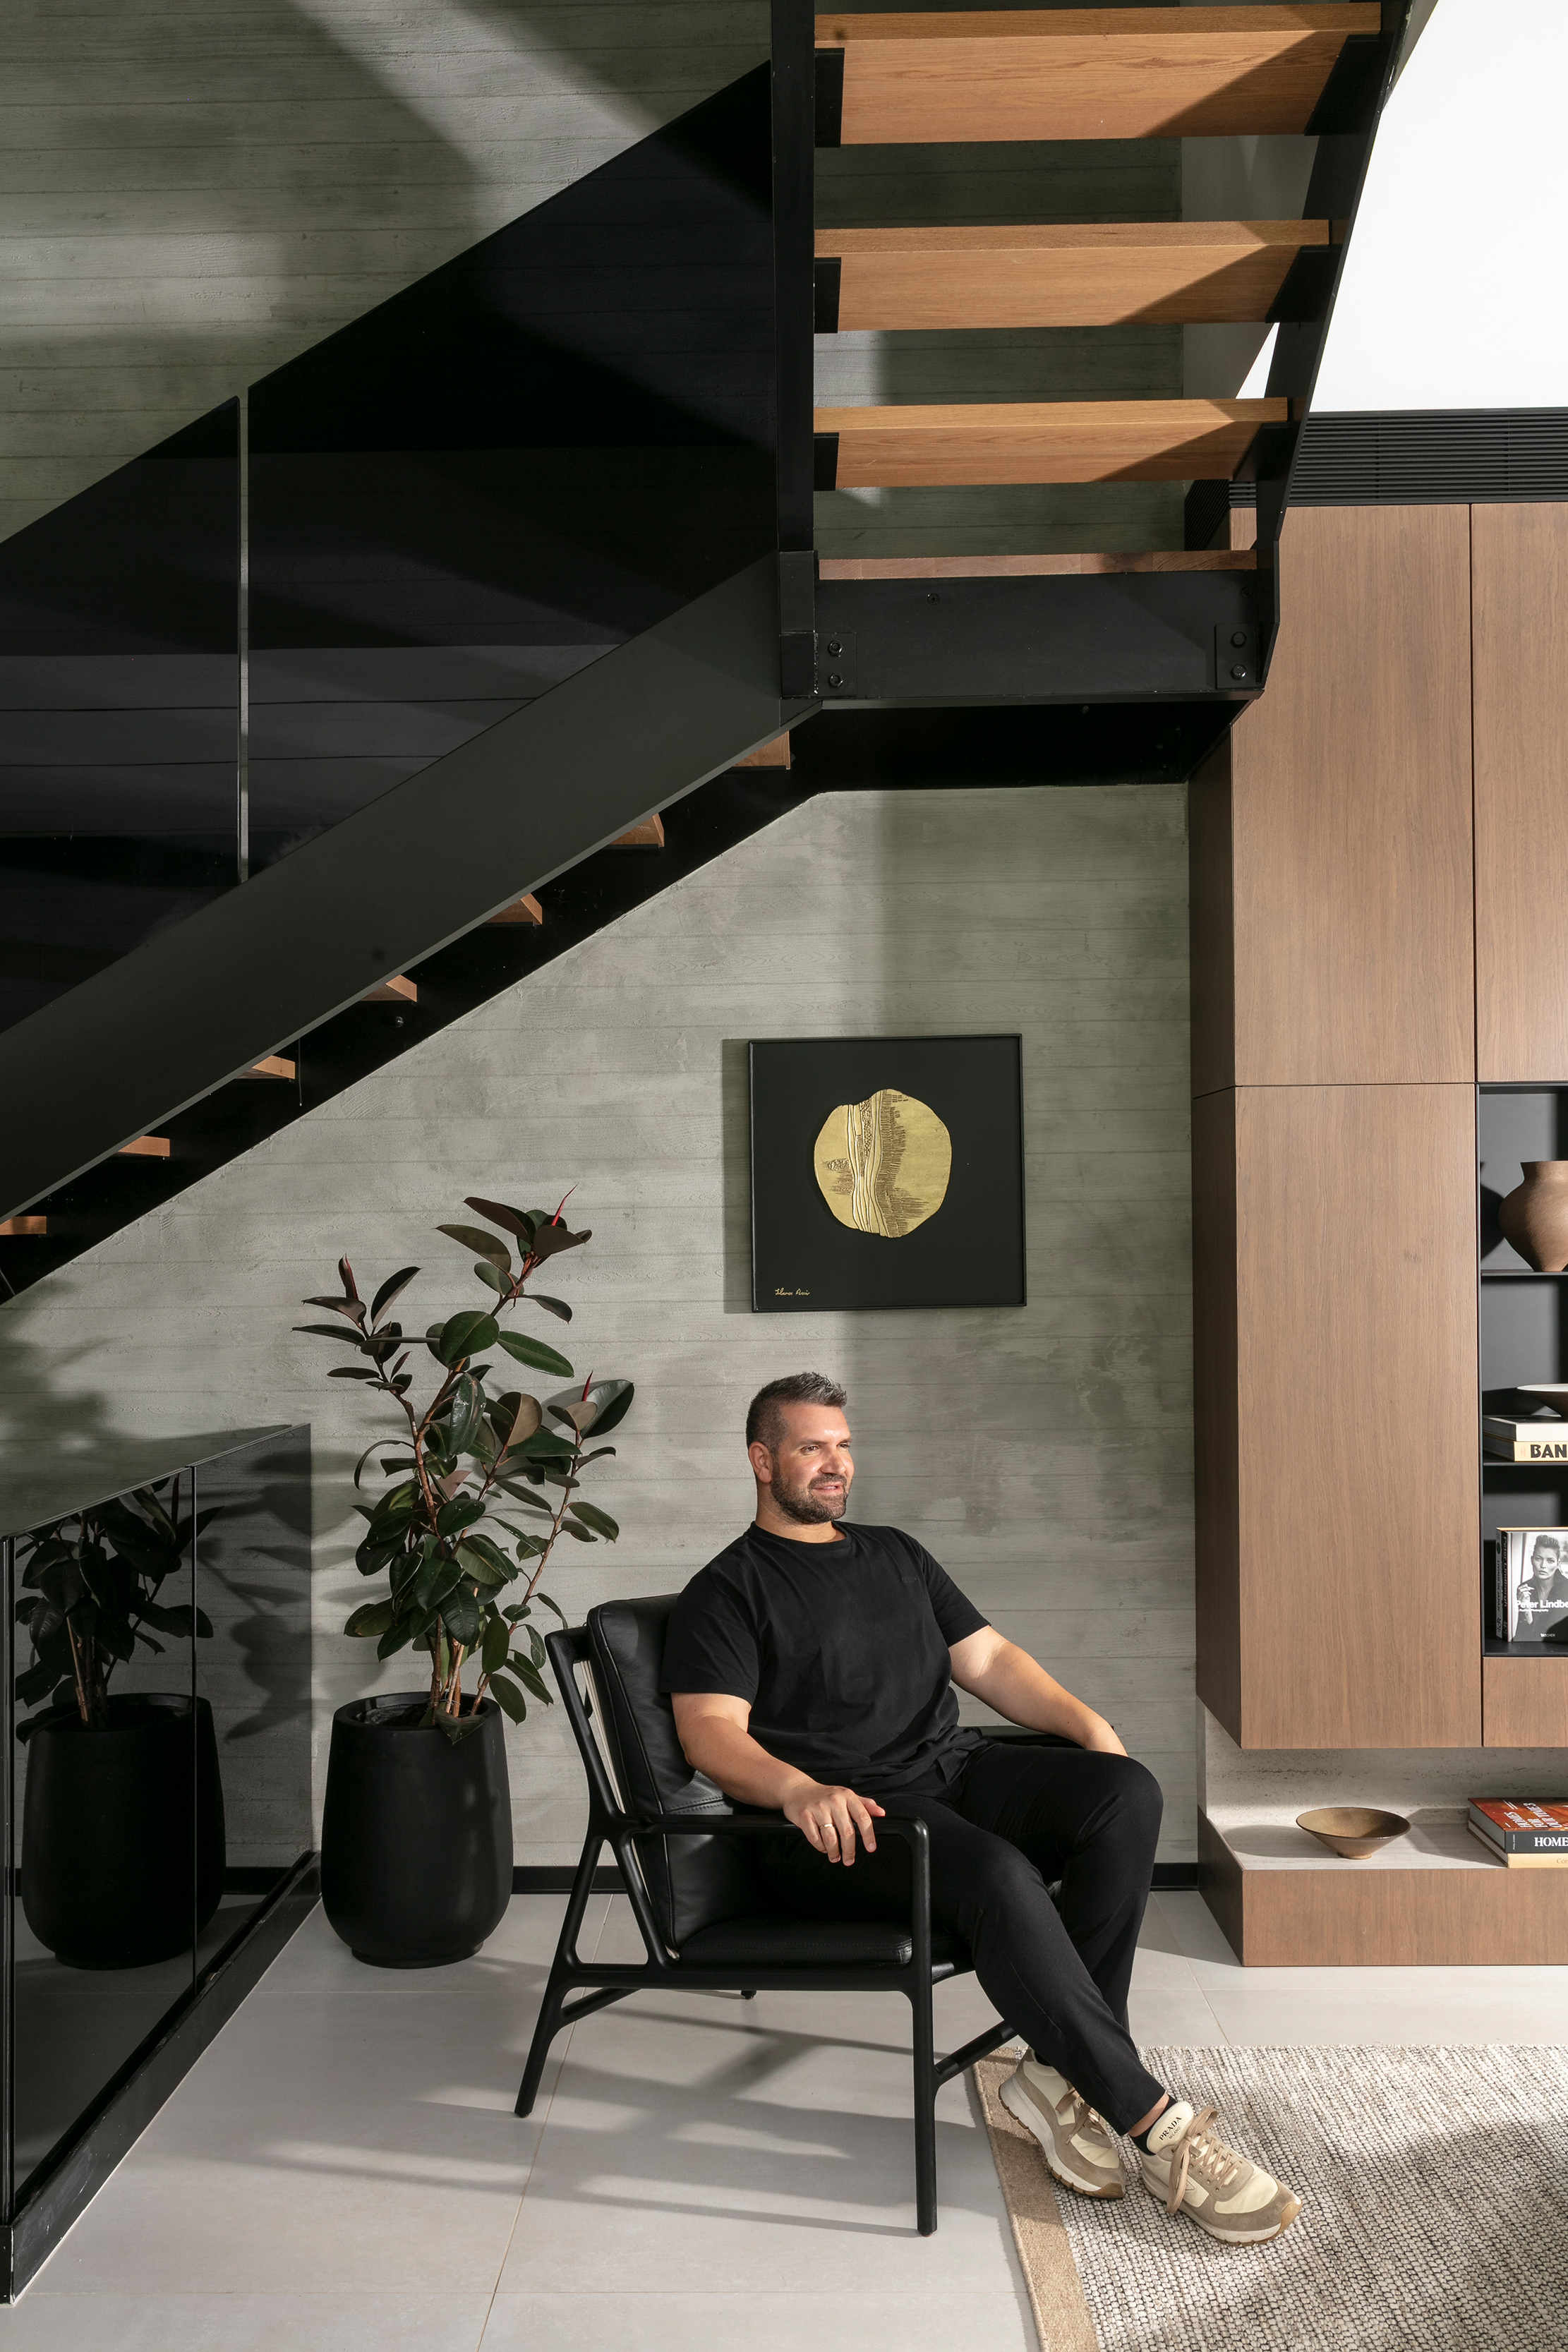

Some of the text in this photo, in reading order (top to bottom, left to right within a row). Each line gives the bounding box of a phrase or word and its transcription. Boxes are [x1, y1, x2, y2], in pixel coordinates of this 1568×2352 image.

[1530, 1444, 1567, 1458] BAN
[1516, 1600, 1538, 1608] Peter
[1527, 1819, 1548, 1828] FOR
[1541, 1817, 1562, 1828] OUR
[1159, 2117, 1182, 2141] PRADA
[1169, 2126, 1181, 2140] MILANO
